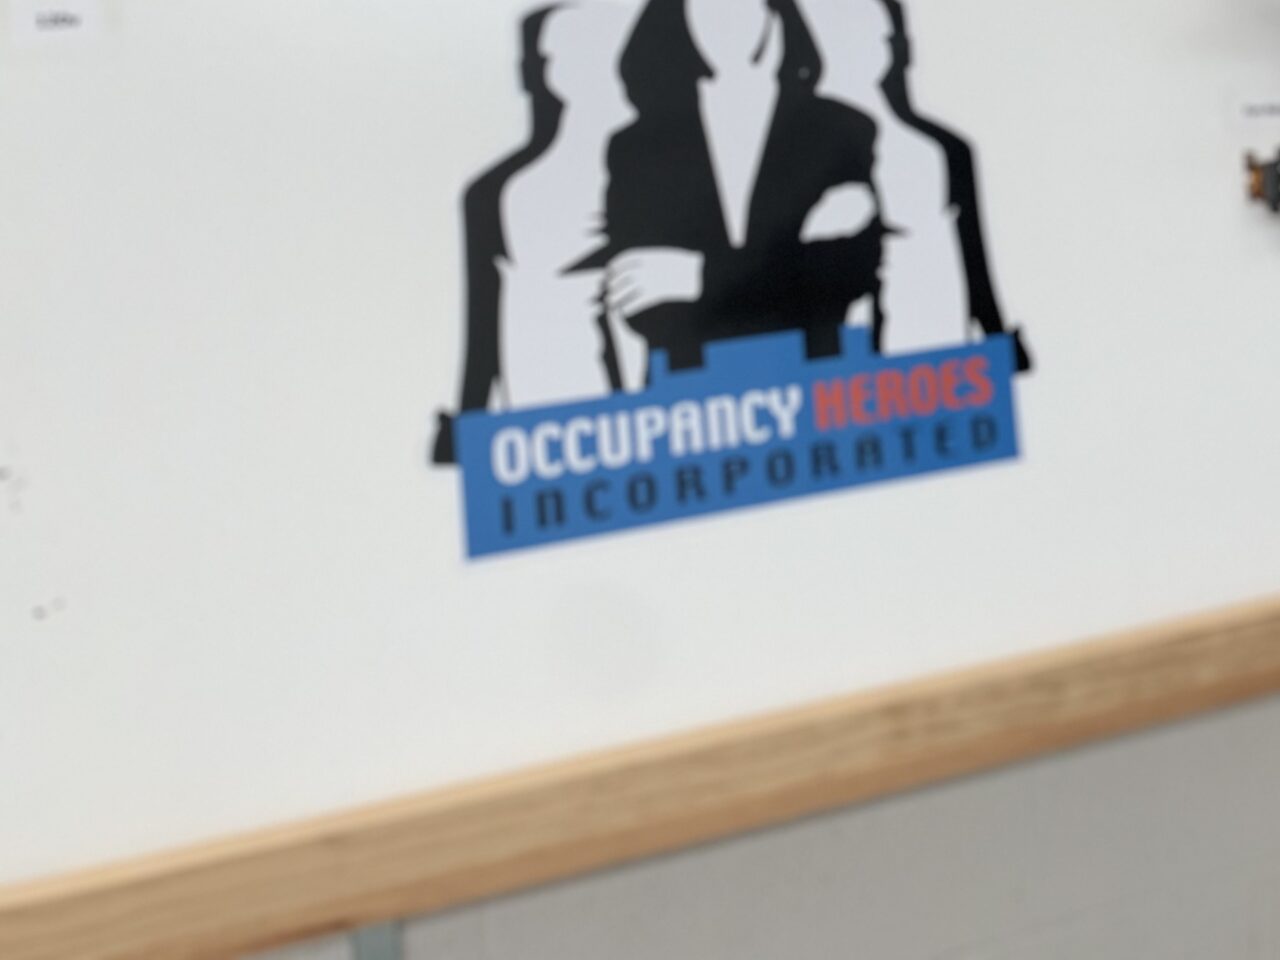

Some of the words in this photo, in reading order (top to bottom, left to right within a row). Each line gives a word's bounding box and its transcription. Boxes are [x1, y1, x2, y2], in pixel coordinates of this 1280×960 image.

[491, 384, 802, 486] OCCUPANCY
[813, 355, 994, 431] HEROES
[501, 414, 999, 535] INCORPORATED
